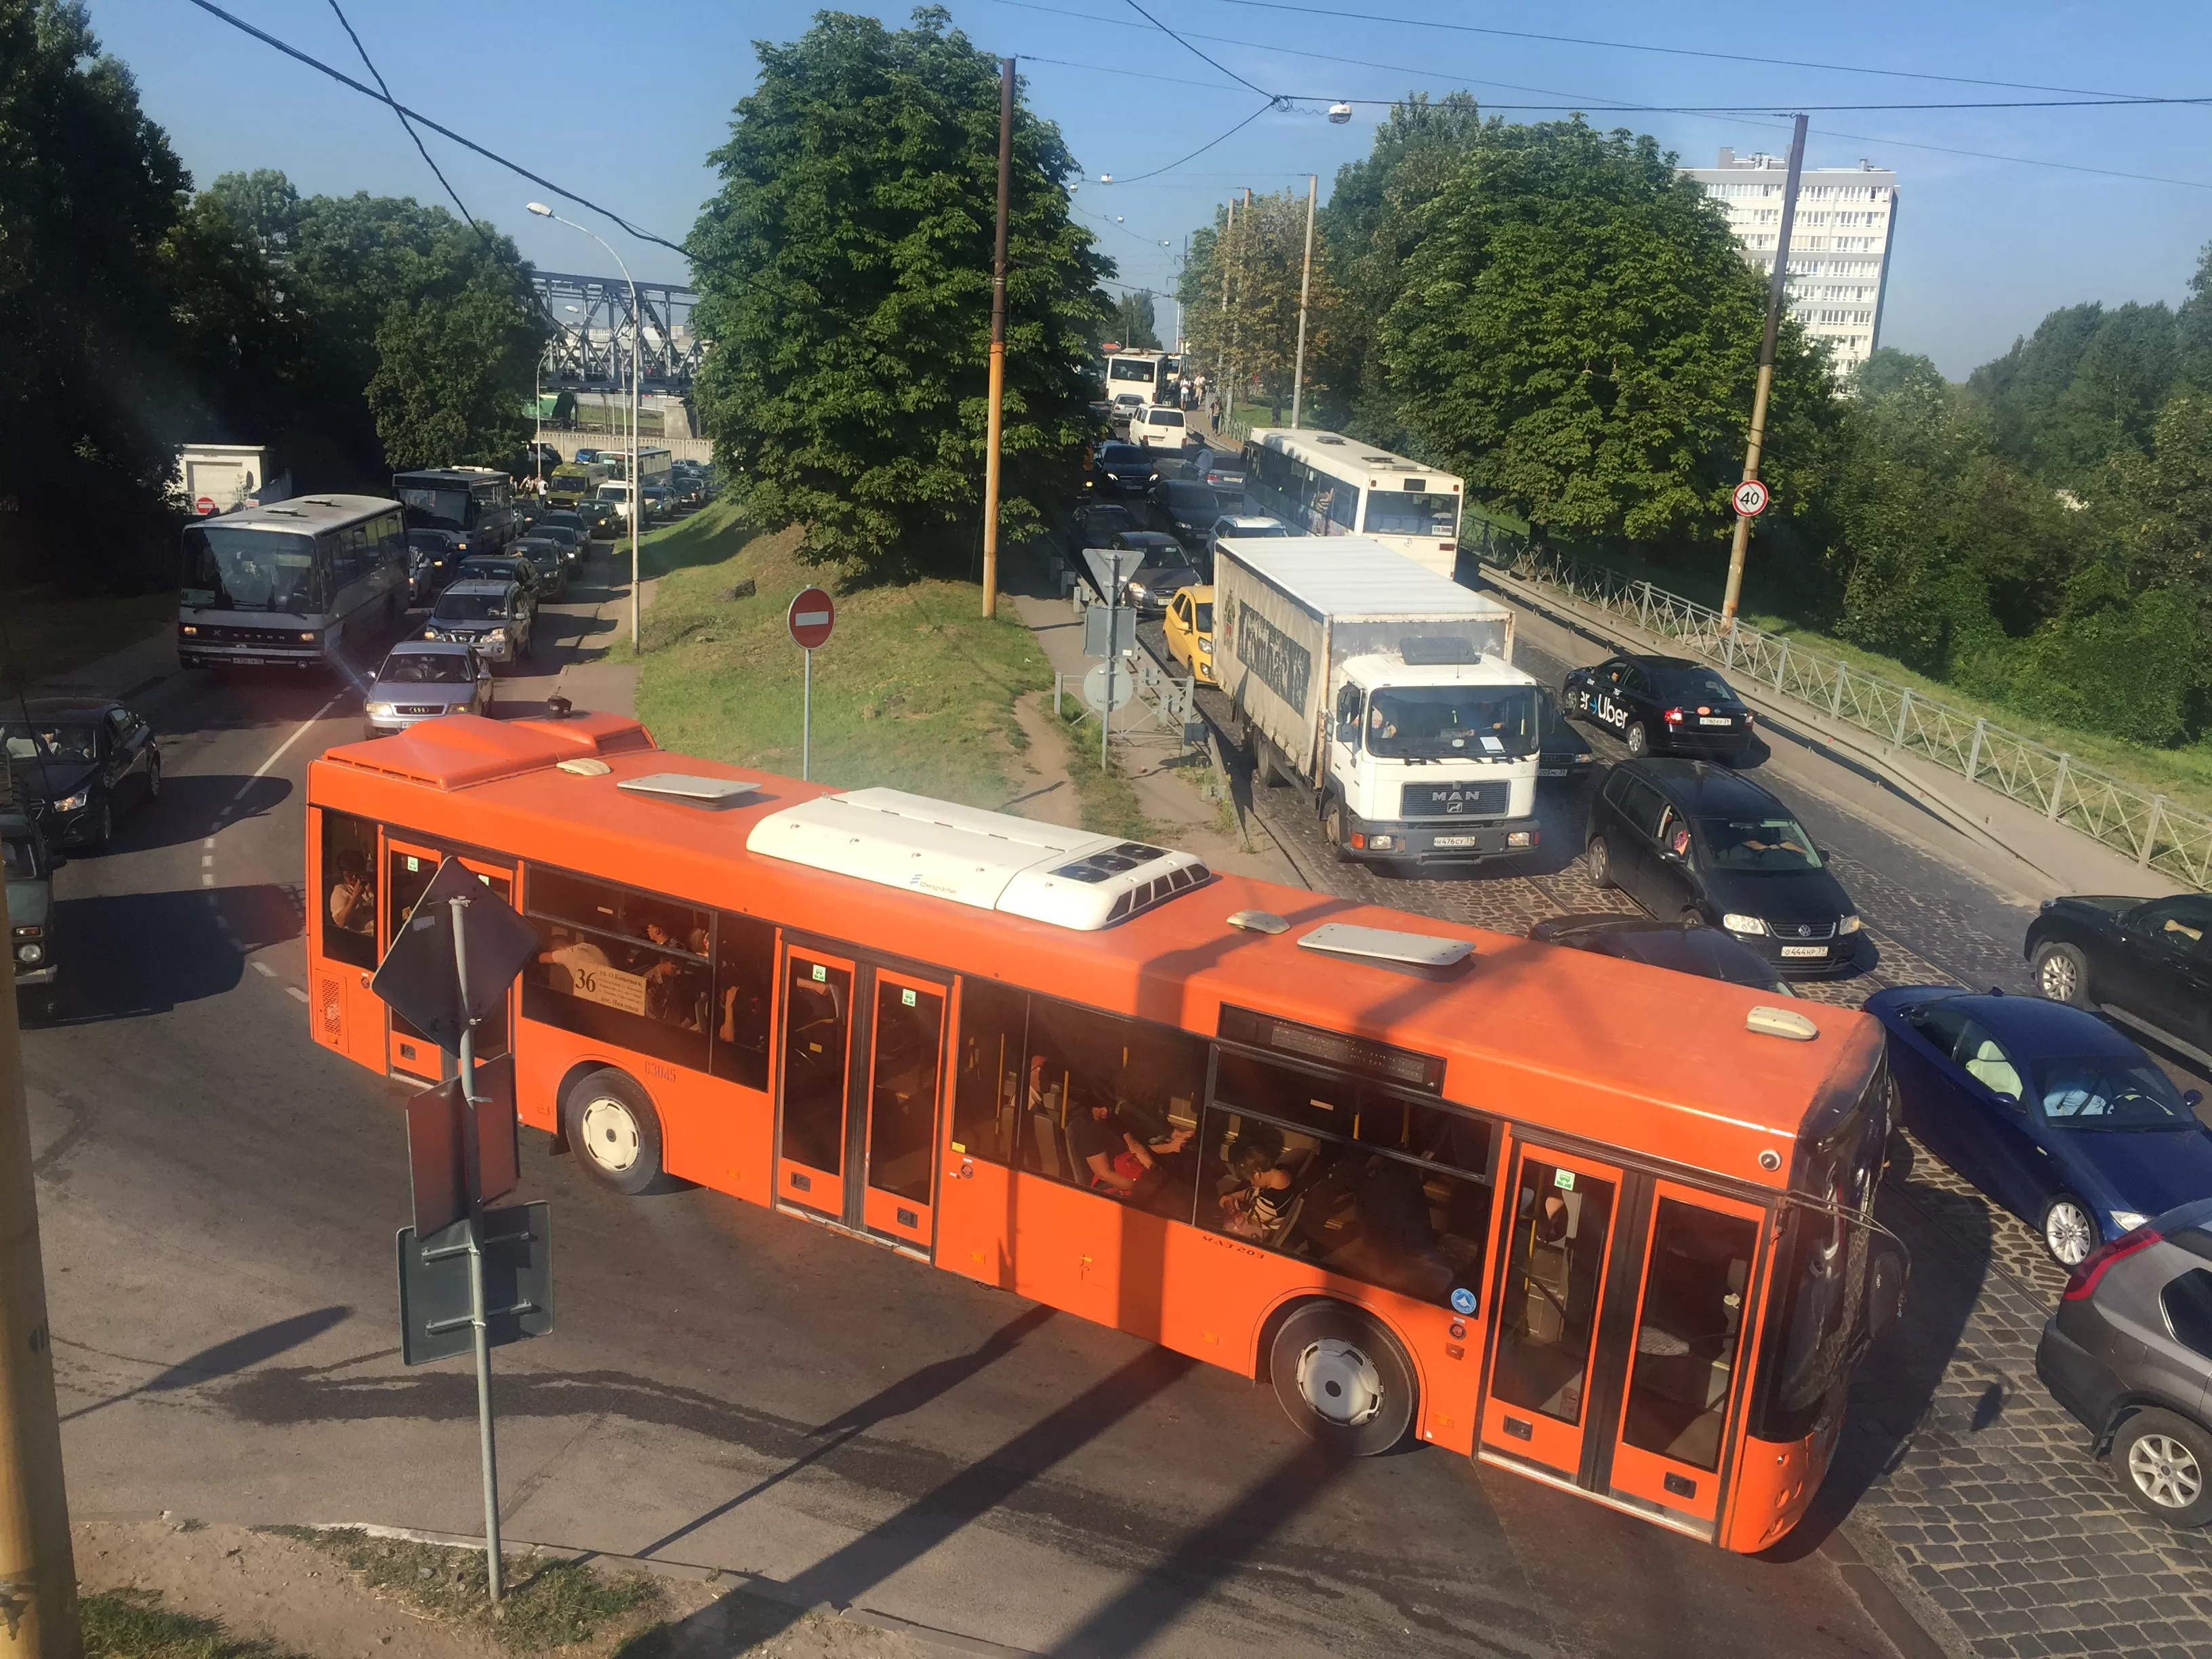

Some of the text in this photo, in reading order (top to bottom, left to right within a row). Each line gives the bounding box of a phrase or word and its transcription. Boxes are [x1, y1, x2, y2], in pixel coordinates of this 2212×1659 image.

[1740, 491, 1759, 505] 40
[1598, 693, 1629, 729] Uber
[1432, 792, 1479, 800] MAN
[575, 968, 596, 992] 36
[644, 1061, 676, 1082] 63045
[1202, 1235, 1265, 1259] МАЗ 203
